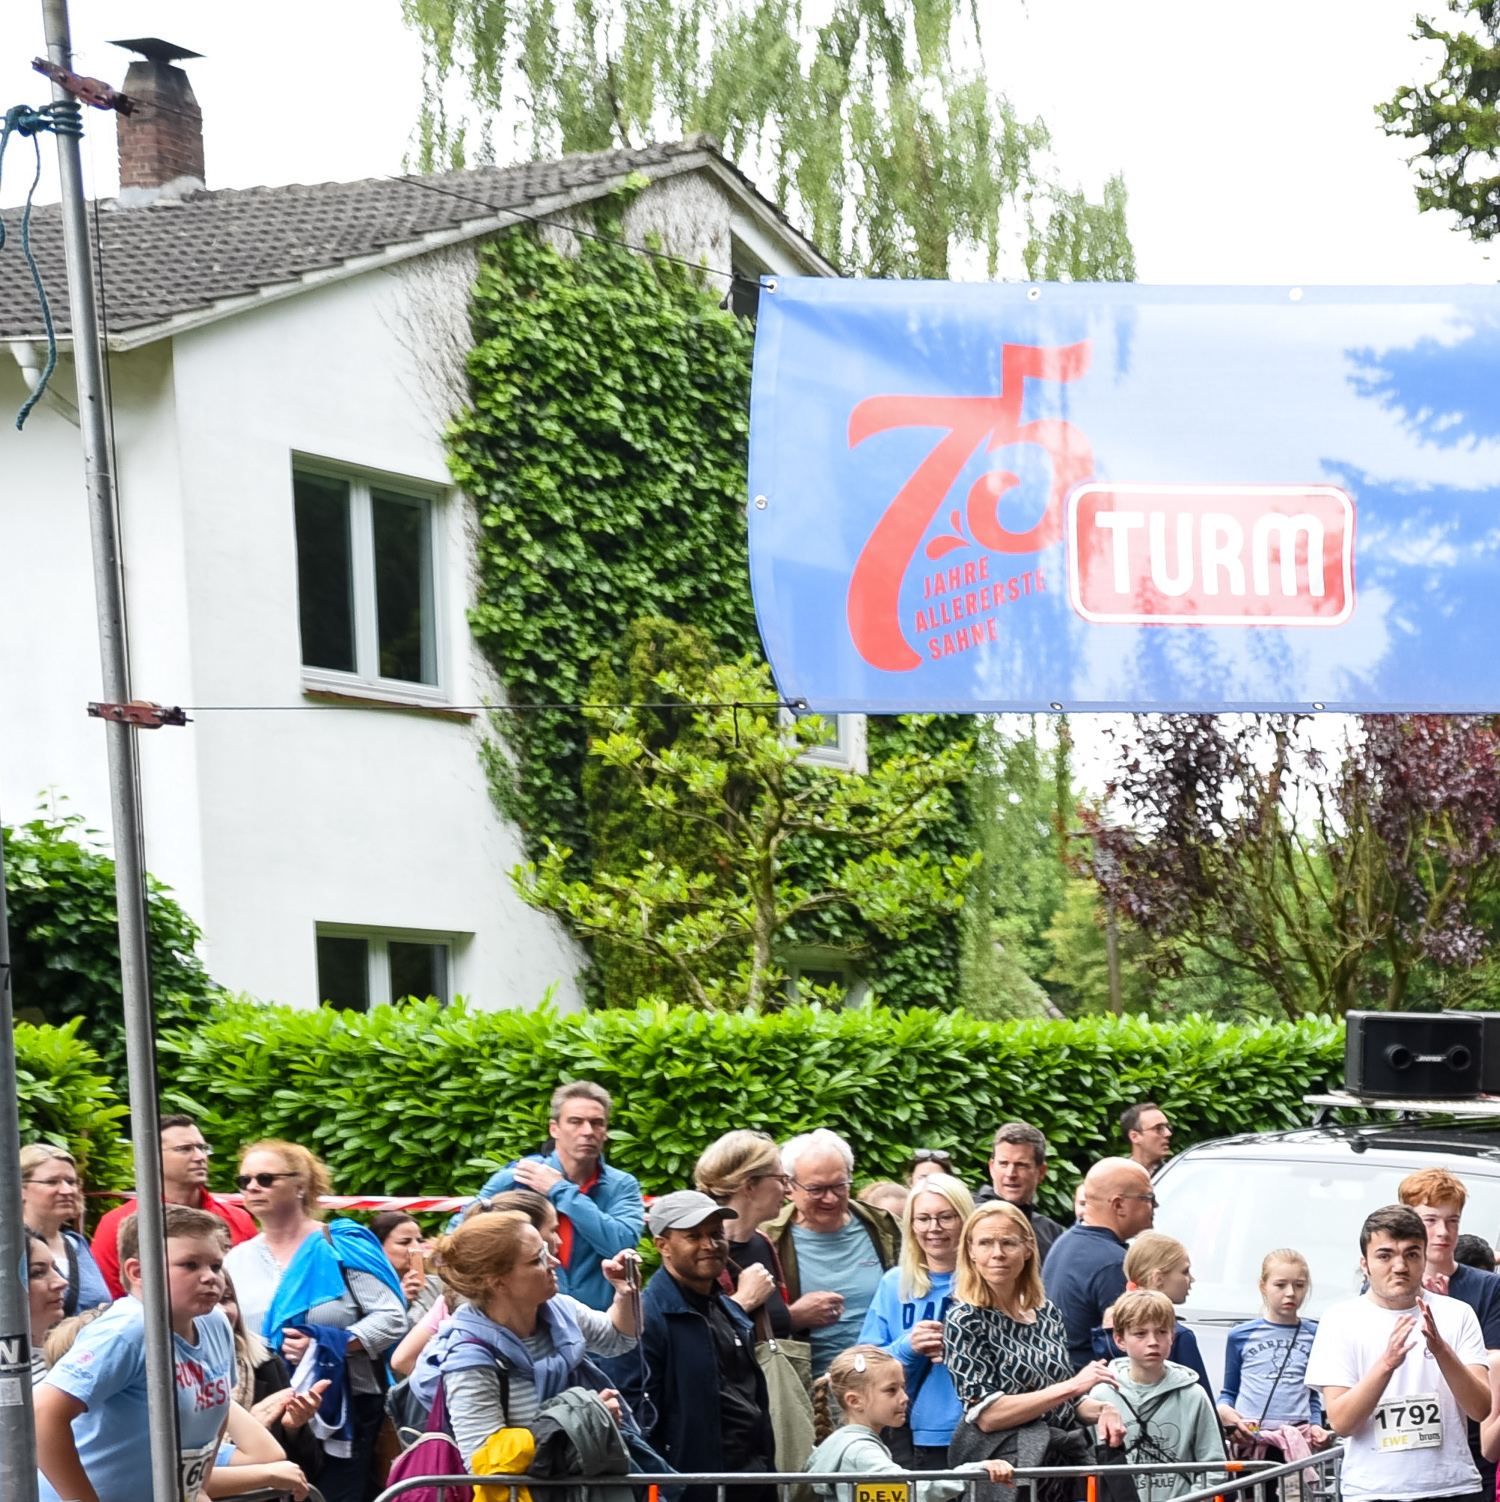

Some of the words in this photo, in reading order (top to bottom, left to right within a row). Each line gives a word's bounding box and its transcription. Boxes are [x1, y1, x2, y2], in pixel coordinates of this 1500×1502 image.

[847, 339, 1096, 672] 75
[1095, 510, 1325, 598] TURM
[915, 567, 1047, 633] ALLERERSTE
[923, 555, 990, 600] JAHRE
[928, 616, 999, 661] SAHNE
[0, 1339, 20, 1364] N
[1375, 1403, 1441, 1430] 1792
[1383, 1434, 1408, 1447] EWE
[1419, 1431, 1441, 1442] bruns
[859, 1490, 906, 1502] D.E.V.
